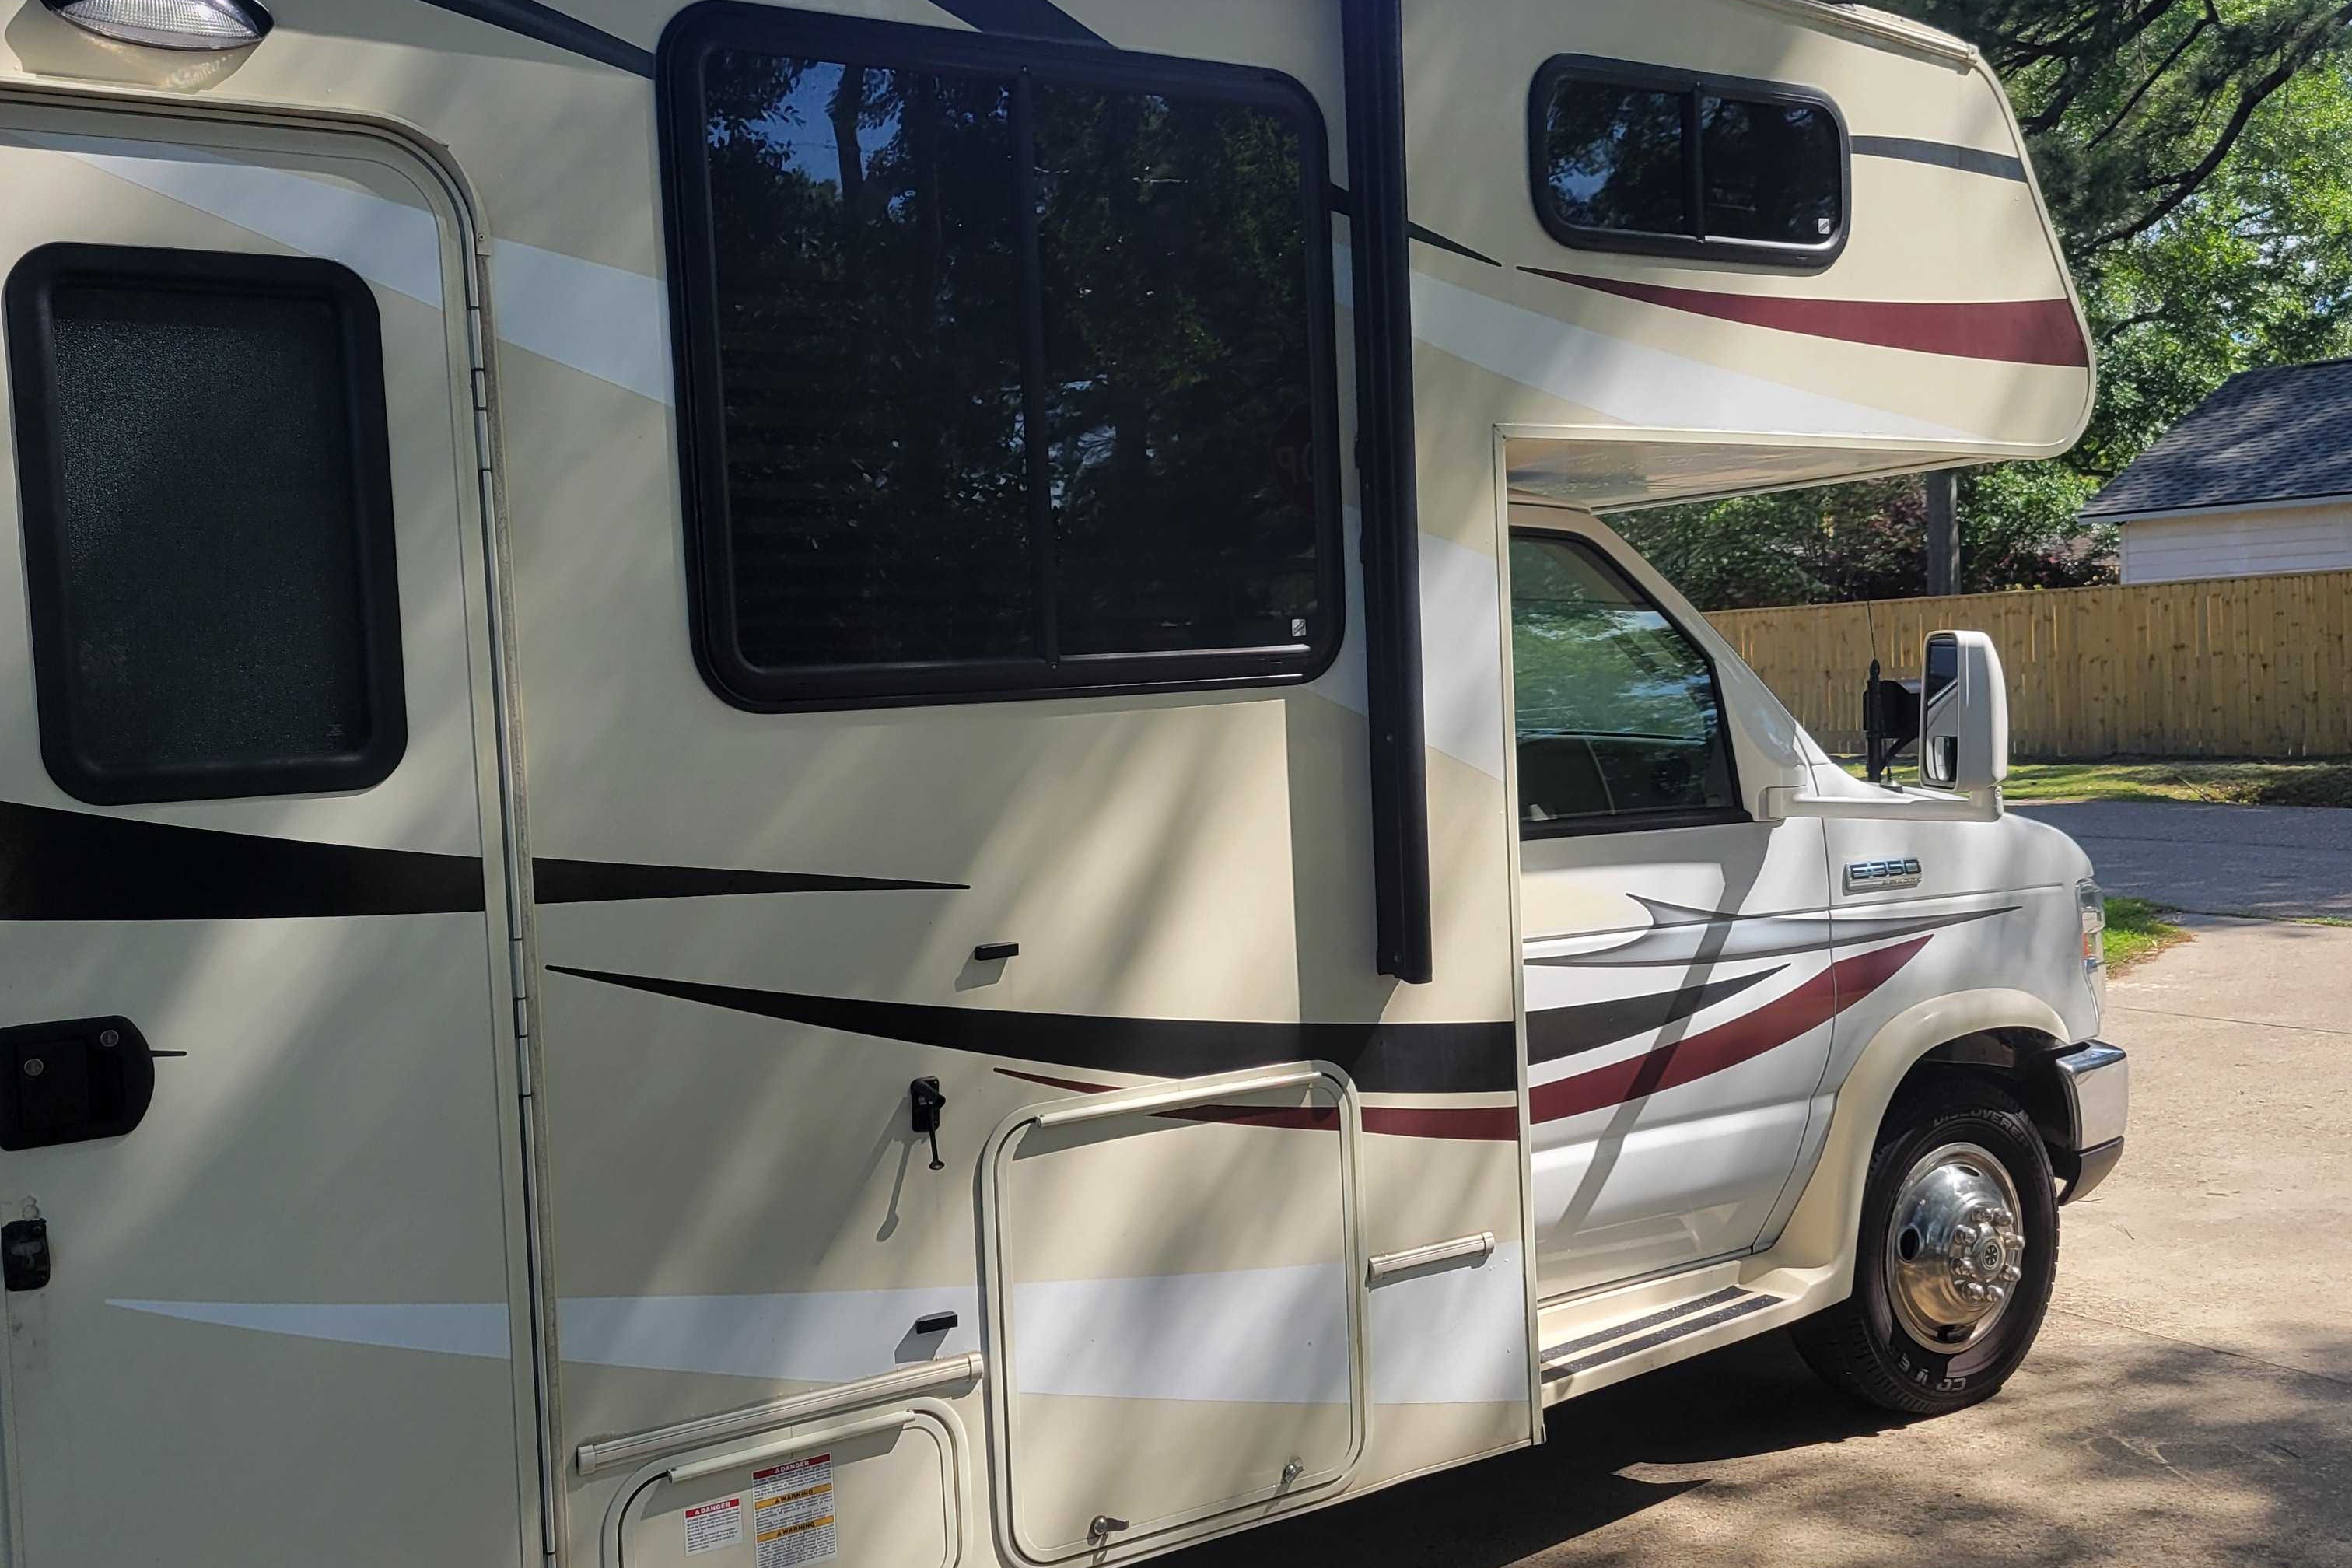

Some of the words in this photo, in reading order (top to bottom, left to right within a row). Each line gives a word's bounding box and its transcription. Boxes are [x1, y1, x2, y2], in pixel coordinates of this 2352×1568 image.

[1933, 1108, 2029, 1146] DIOVERE
[780, 1460, 810, 1473] DANGER
[781, 1487, 814, 1503] WARNING
[700, 1501, 731, 1514] DANGER
[782, 1521, 815, 1535] WARNING
